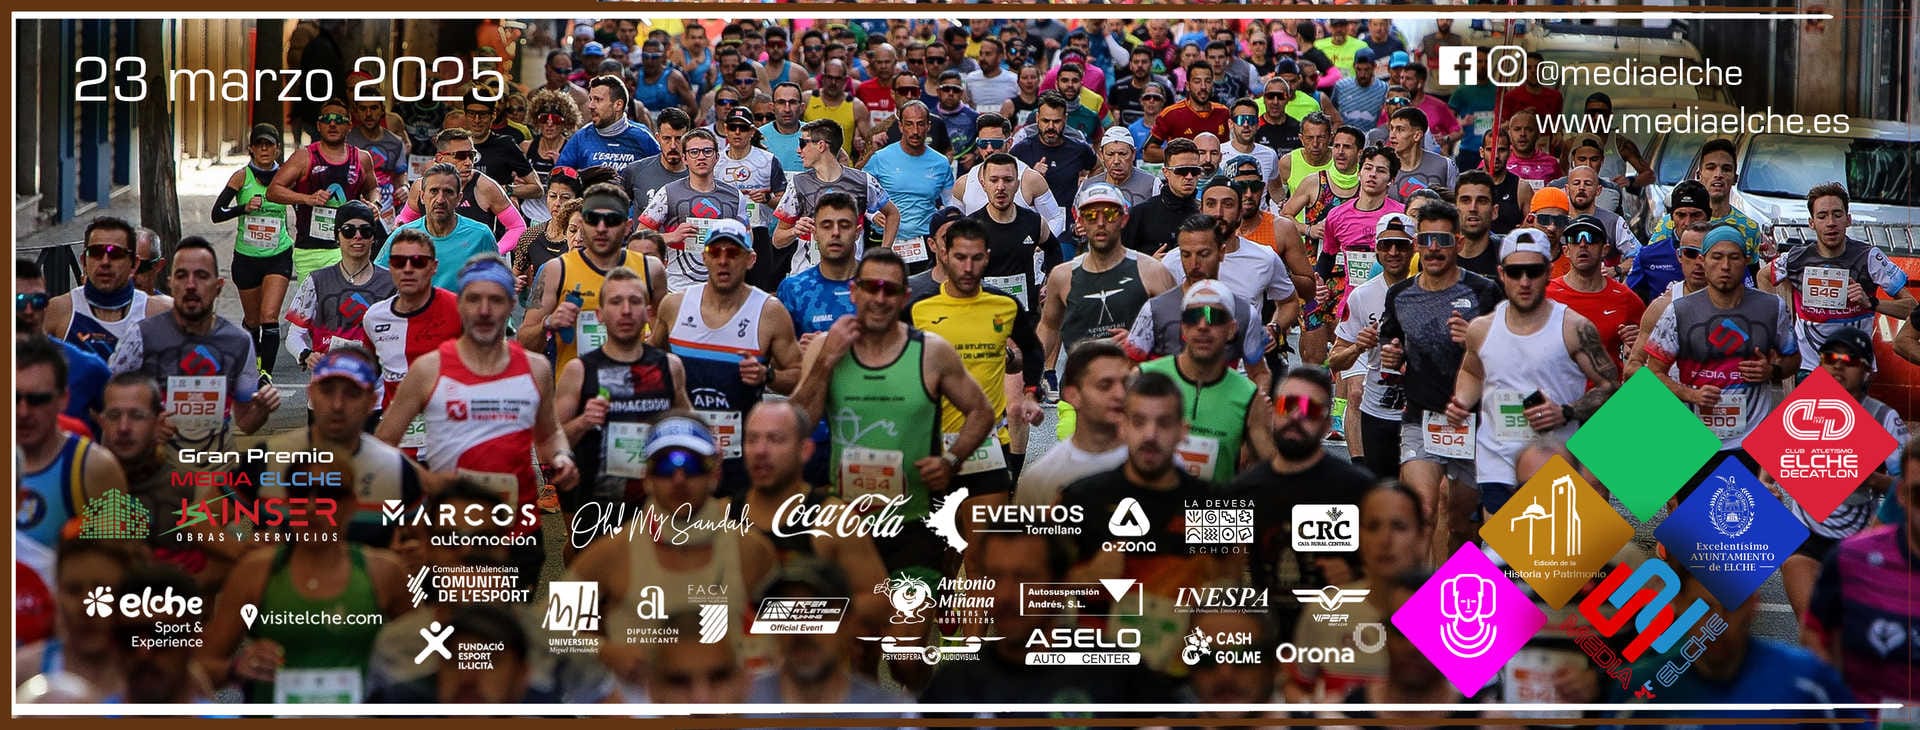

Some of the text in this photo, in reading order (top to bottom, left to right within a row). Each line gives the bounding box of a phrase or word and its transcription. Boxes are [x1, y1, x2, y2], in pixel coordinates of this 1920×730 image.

[250, 231, 272, 240] 1195
[1809, 287, 1839, 298] 846
[694, 394, 730, 408] APM
[174, 402, 216, 415] 1032
[1703, 416, 1737, 427] 900
[1431, 434, 1465, 446] 904
